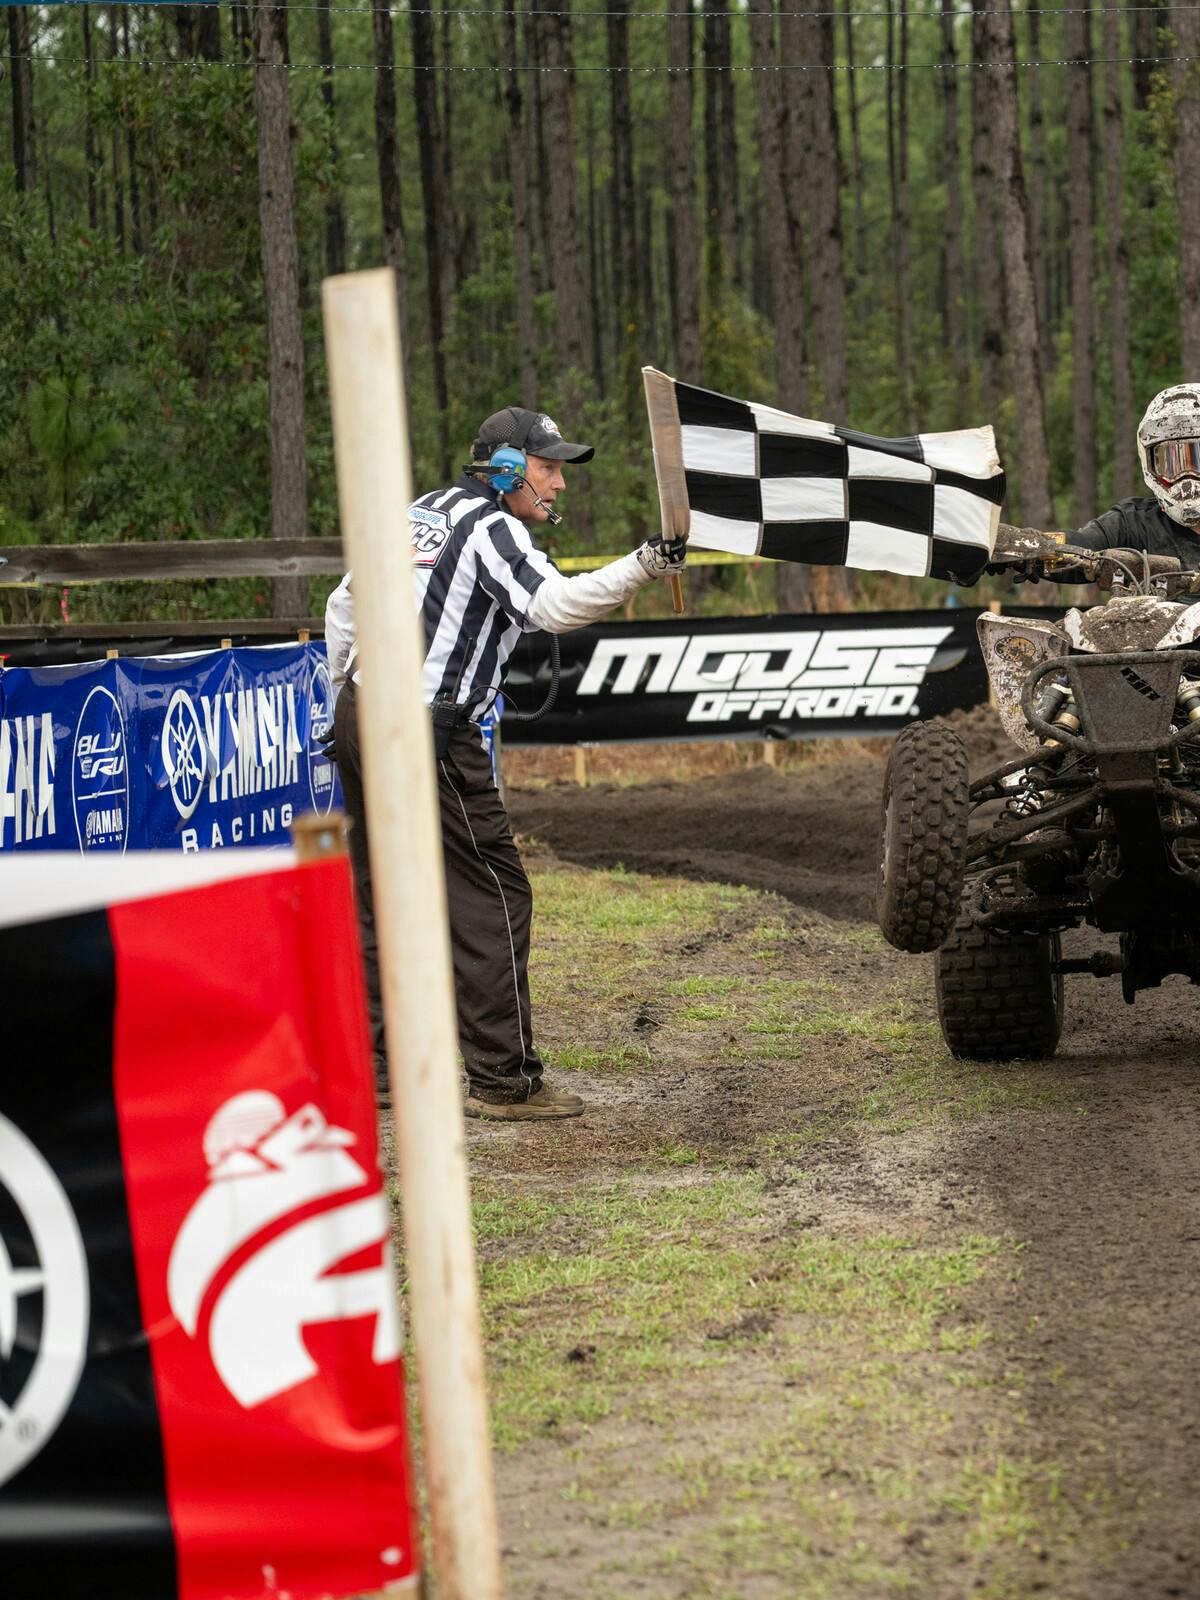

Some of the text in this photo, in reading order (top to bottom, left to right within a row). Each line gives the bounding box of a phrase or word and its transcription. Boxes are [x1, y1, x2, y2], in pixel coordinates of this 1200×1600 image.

[576, 626, 956, 696] MOOSE
[686, 685, 920, 722] OFFROAD
[77, 732, 121, 757] BLU
[201, 683, 303, 804] YAMAHA
[80, 755, 125, 779] CRU
[181, 802, 293, 855] RACING
